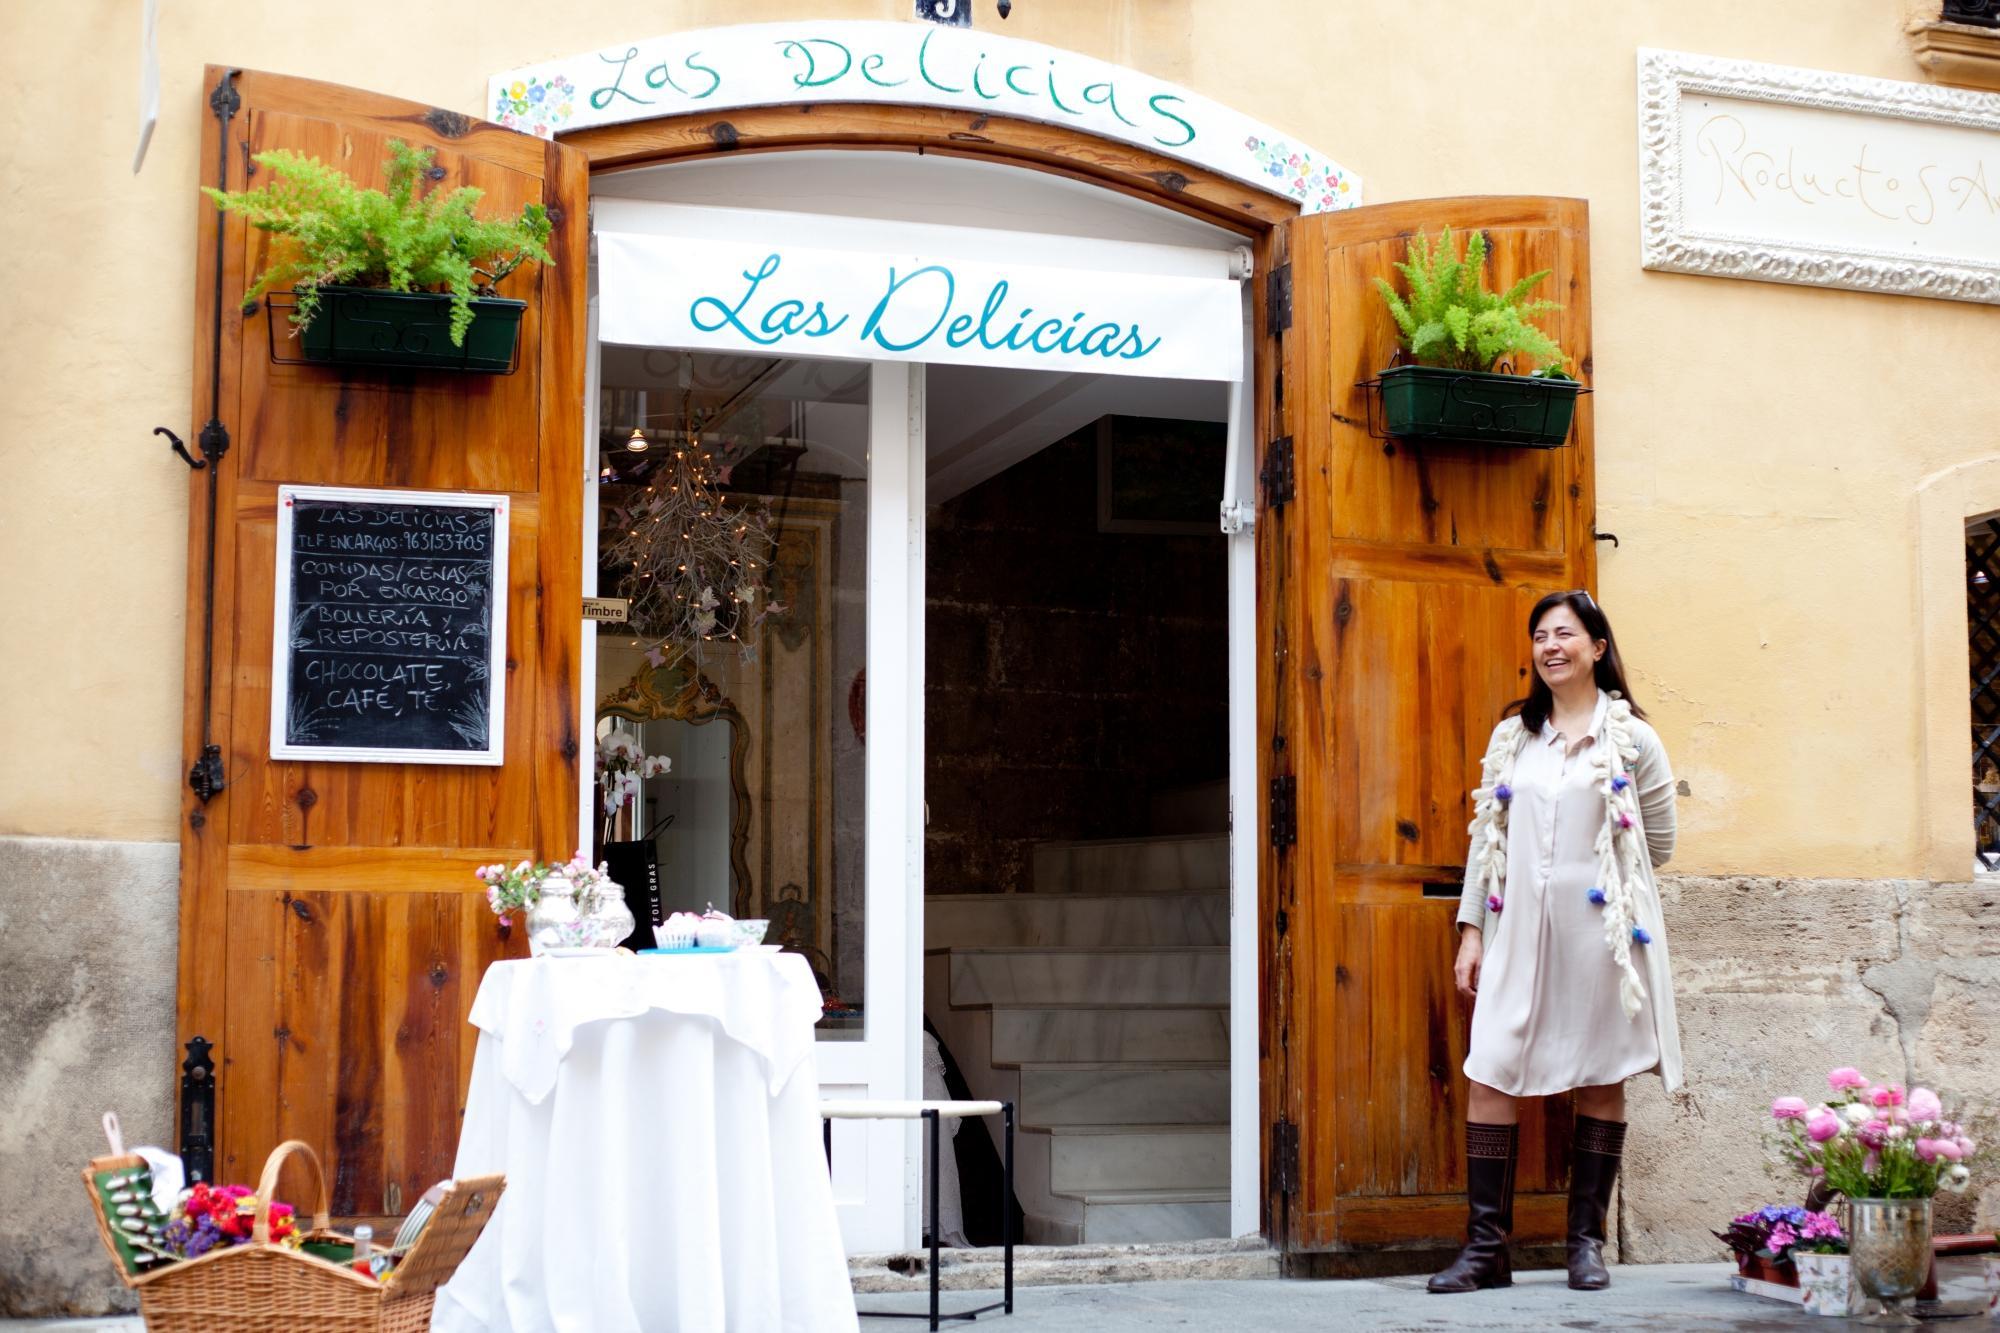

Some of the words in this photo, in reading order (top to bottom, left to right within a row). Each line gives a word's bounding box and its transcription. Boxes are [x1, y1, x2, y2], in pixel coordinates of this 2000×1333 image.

[589, 46, 721, 111] Las
[776, 27, 1196, 148] Delicias
[688, 252, 849, 347] Las
[860, 264, 1162, 361] Delicias
[318, 509, 363, 524] LAS
[320, 580, 370, 599] POR
[379, 583, 469, 608] ENCARGO
[582, 605, 623, 617] Timbre
[648, 863, 658, 891] GRAS
[650, 897, 660, 922] FOIE
